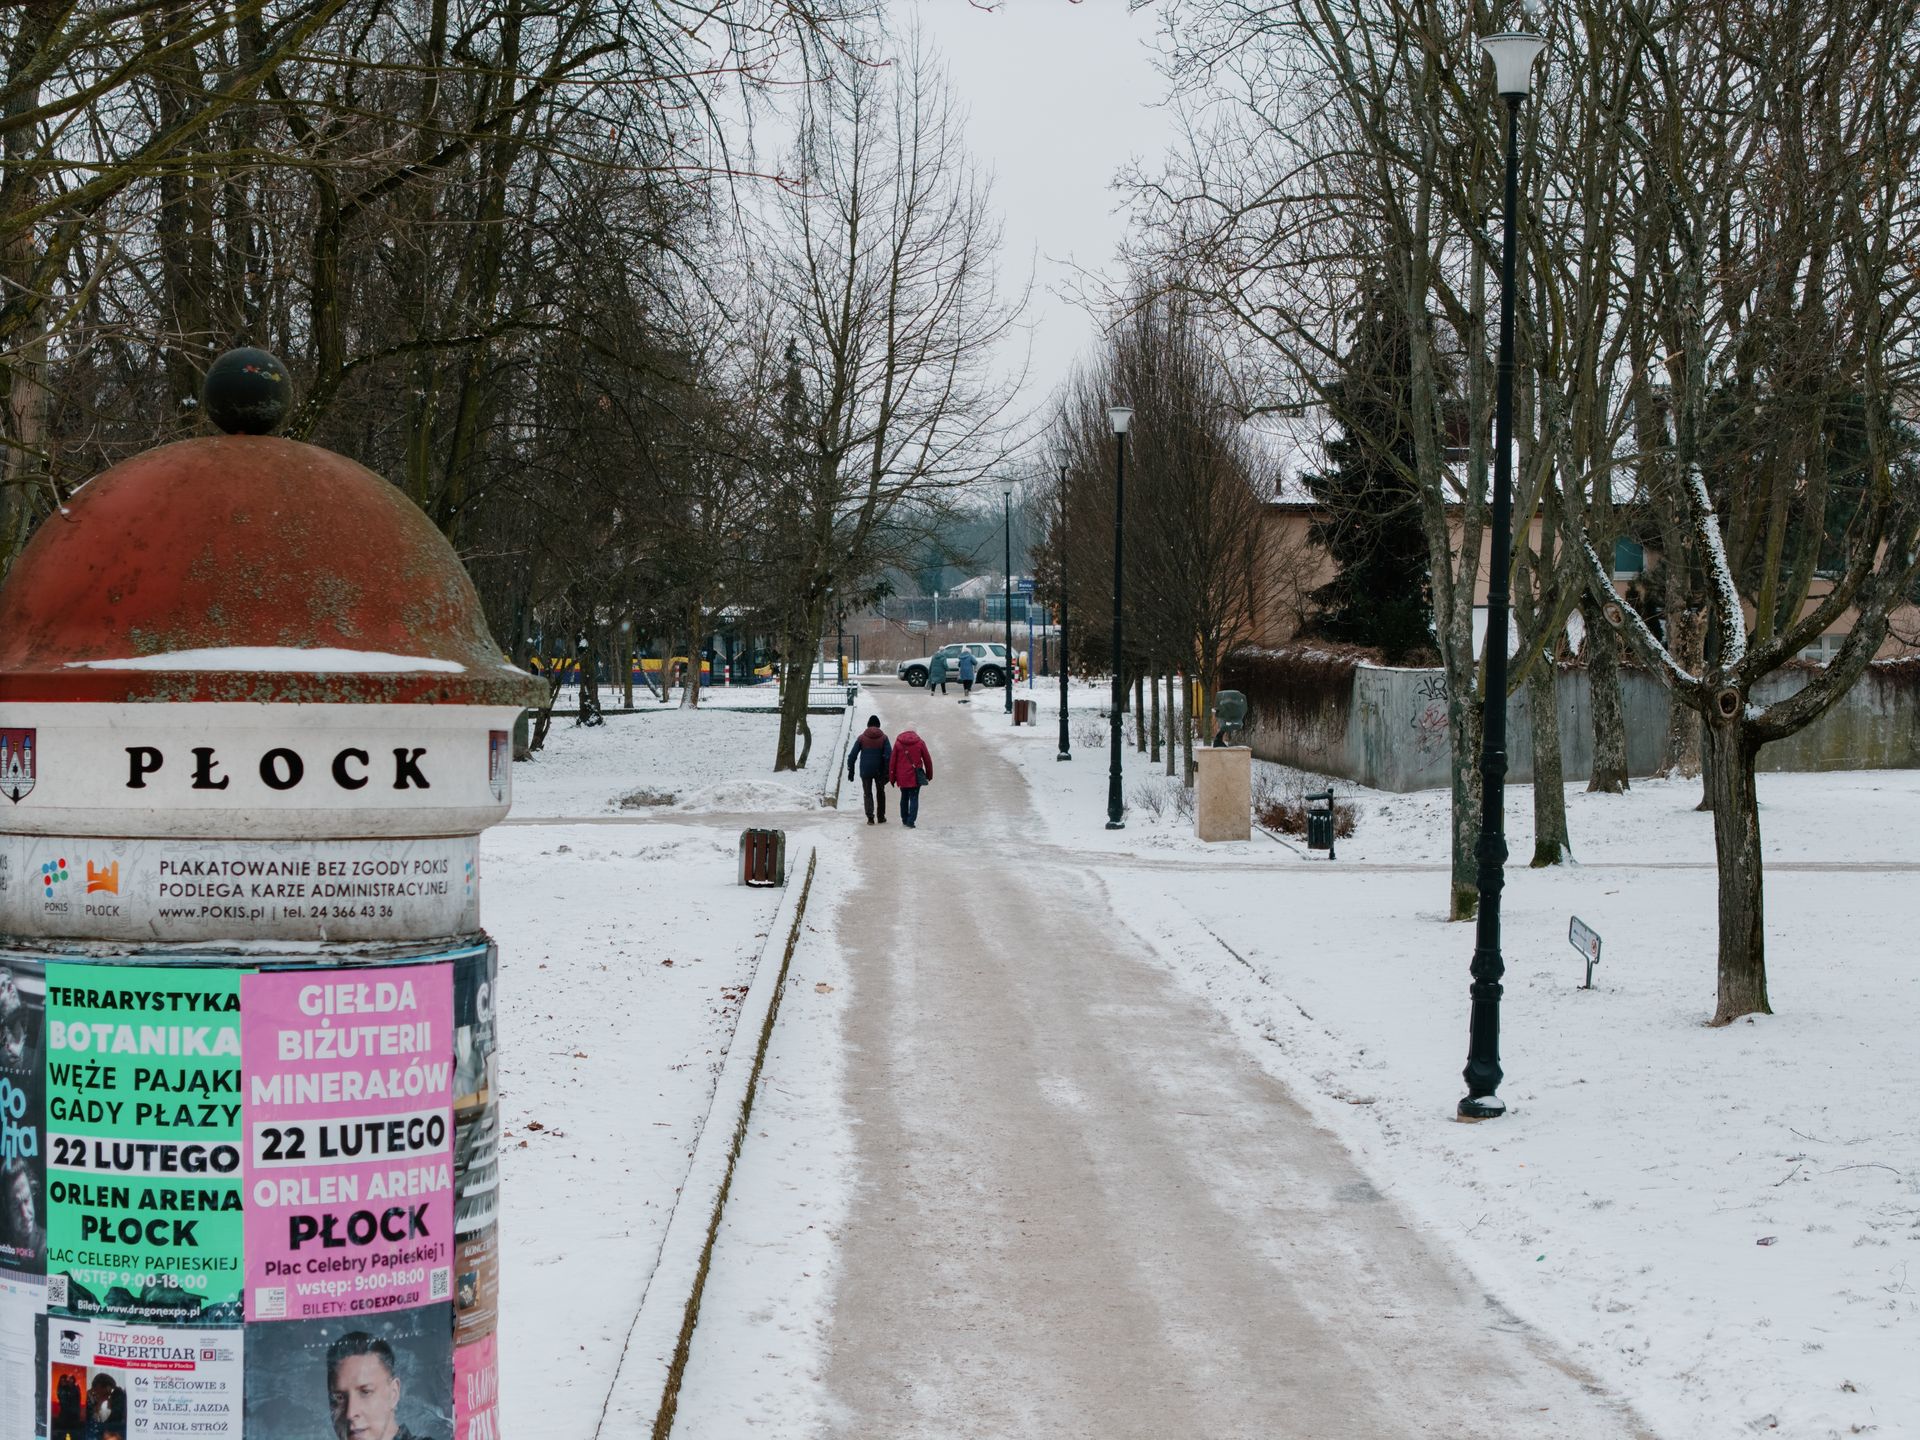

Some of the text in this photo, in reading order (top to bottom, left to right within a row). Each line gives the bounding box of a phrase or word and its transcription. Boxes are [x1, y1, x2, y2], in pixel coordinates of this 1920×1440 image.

[125, 746, 431, 790] PŁOCK
[160, 859, 448, 876] PLAKATOWANIE BEZ ZGODY POKIS
[160, 881, 448, 898] PODLEGA KARZE ADMINISTRACYJNEJ
[45, 902, 68, 912] POKIS
[159, 905, 393, 920] www.POKIS.pl tel. 24 366 43 36
[49, 986, 241, 1012] TERRARYSTYKA
[299, 980, 417, 1016] GIEŁDA
[50, 1021, 241, 1056] BOTANIKA
[278, 1018, 431, 1061] BIŻUTERII
[49, 1059, 241, 1099] WĘŻE PAJĄKI
[251, 1057, 449, 1106] MINERAŁÓW
[50, 1097, 241, 1127] GADY PŁAZY
[261, 1115, 445, 1161] 22 LUTEGO
[53, 1137, 240, 1173] 22 LUTEGO
[50, 1181, 243, 1211] ORLEN ARENA
[253, 1163, 451, 1208] ORLEN ARENA
[81, 1214, 199, 1247] PŁOCK
[289, 1203, 430, 1251] PŁOCK
[78, 1251, 140, 1268] CELEBRY
[145, 1256, 238, 1271] PAPIESKIEJ
[265, 1260, 302, 1276] Plac
[306, 1256, 367, 1274] Celebry
[371, 1245, 438, 1270] Papieskiej
[71, 1268, 208, 1289] WSTĘP 9:00-18:00
[296, 1268, 425, 1299] wstęp: 9:00-18:00
[302, 1301, 347, 1315] BILETY:
[350, 1291, 419, 1312] GEOEXPO.EU
[61, 1341, 80, 1350] KINO
[98, 1331, 164, 1345] LUTY 2026
[98, 1342, 196, 1360] REPERTUAR
[134, 1377, 148, 1386] 04
[153, 1379, 216, 1390] TEŚCIOWIE
[220, 1382, 226, 1390] 3
[134, 1399, 147, 1408] 07
[194, 1404, 230, 1412] JAZDA
[134, 1418, 148, 1427] 07
[153, 1422, 188, 1431] ANIOŁ
[191, 1421, 228, 1431] STRÓŻ
